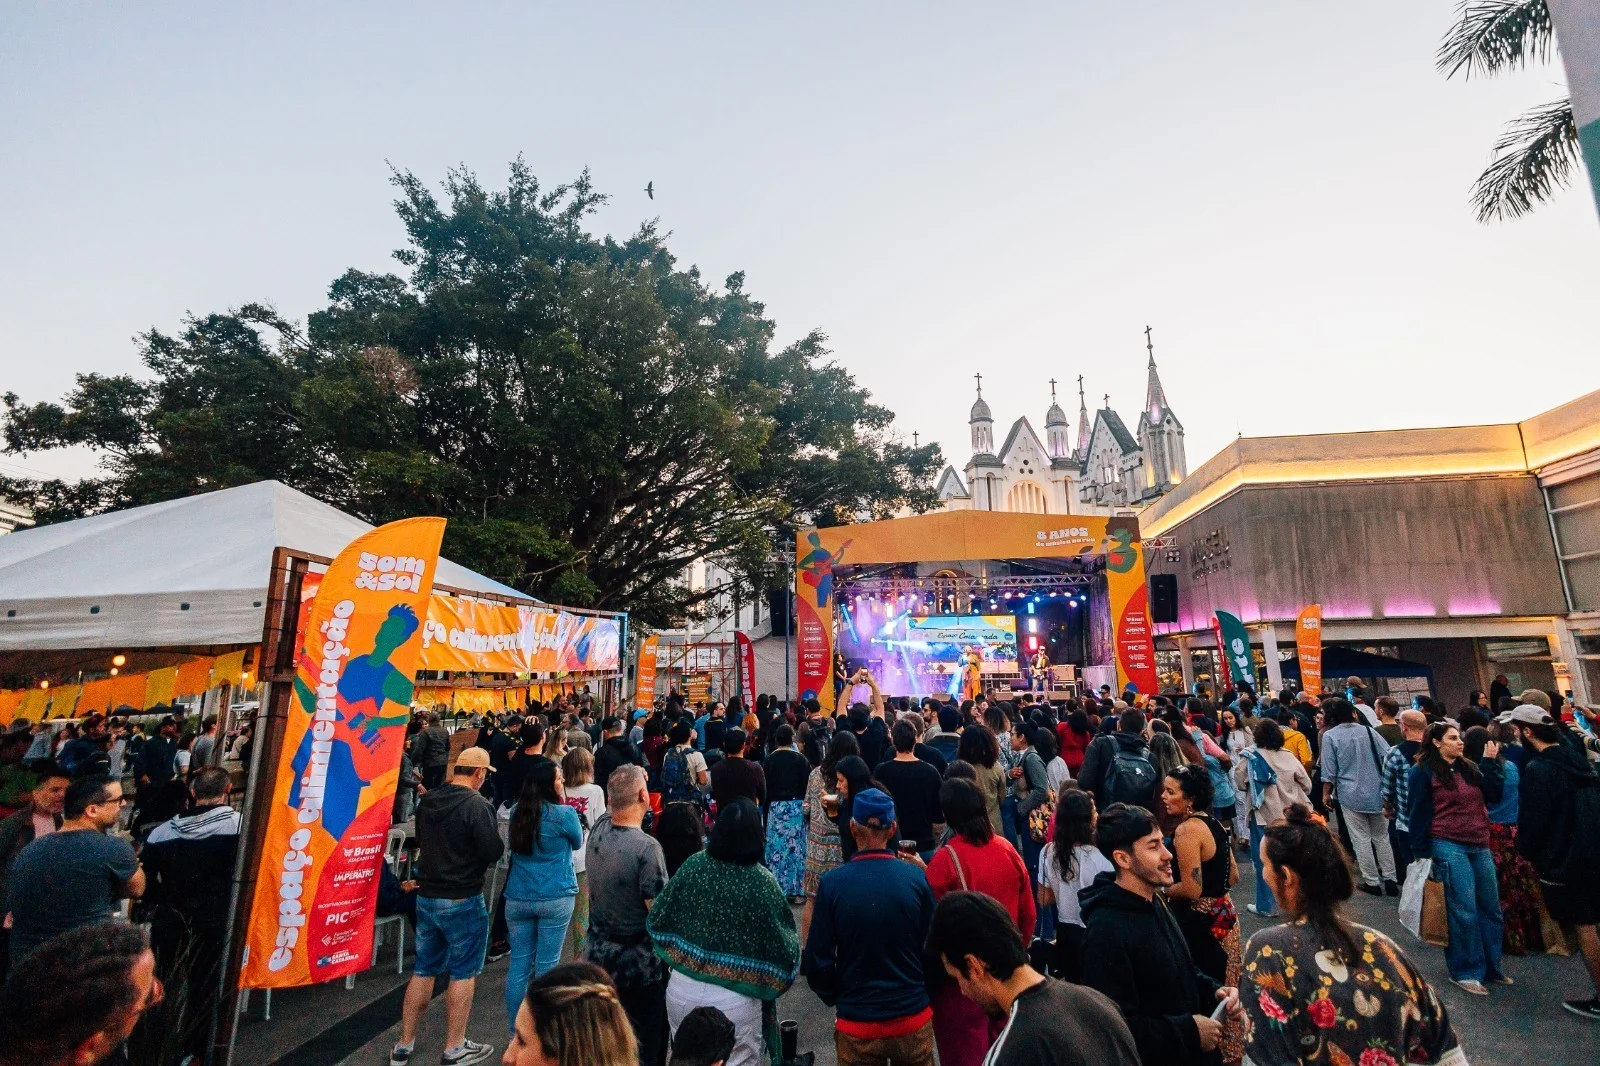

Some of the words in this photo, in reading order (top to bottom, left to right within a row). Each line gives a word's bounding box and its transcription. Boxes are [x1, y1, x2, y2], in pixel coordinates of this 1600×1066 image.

[1036, 531, 1047, 540] 8
[1050, 527, 1088, 540] ANOS
[450, 627, 558, 655] alimenção
[1231, 637, 1256, 692] rte
[268, 827, 314, 971] espaço
[297, 599, 355, 824] alimentação
[353, 843, 381, 857] Brasil
[325, 911, 350, 926] PIC
